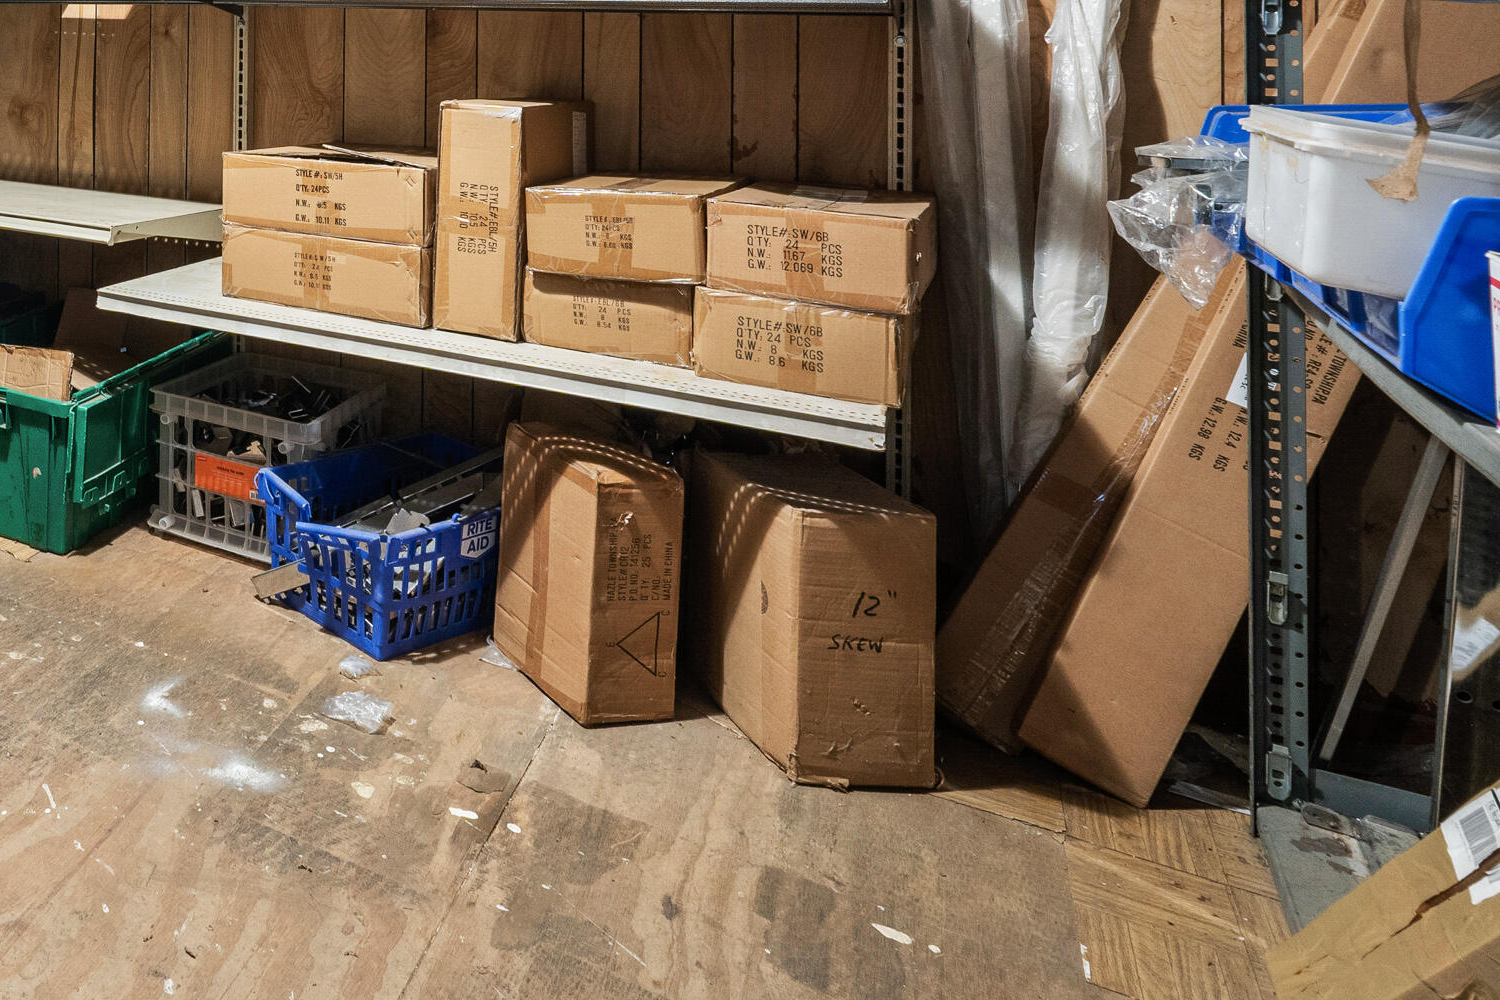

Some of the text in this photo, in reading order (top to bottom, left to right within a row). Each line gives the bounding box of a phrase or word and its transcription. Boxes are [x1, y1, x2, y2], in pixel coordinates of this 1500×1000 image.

[295, 168, 312, 178] STYLE
[334, 202, 346, 211] KGS
[334, 217, 347, 227] KGS
[477, 215, 488, 255] 24 PCS
[619, 233, 632, 241] KGS
[457, 236, 467, 253] KGS
[466, 237, 477, 255] KGS
[620, 242, 633, 250] KGS
[785, 239, 799, 250] 24
[821, 243, 842, 255] PCS
[821, 255, 843, 266] KGS
[780, 261, 814, 274] 12.069
[821, 266, 843, 278] KGS
[617, 308, 631, 316] PCS
[618, 316, 630, 324] KGS
[618, 324, 630, 332] KGS
[766, 332, 781, 344] 24
[789, 335, 811, 348] PCS
[770, 344, 777, 355] 8
[802, 349, 824, 361] KGS
[768, 355, 786, 367] 8.6
[801, 360, 824, 373] KGS
[1197, 416, 1218, 440] 12.98
[1188, 443, 1206, 461] KGS
[1213, 430, 1242, 473] 12.4 KGS
[467, 518, 493, 536] RITE
[466, 536, 490, 555] AID
[630, 537, 640, 568] 141256
[642, 533, 652, 569] 25 PCS
[663, 541, 674, 601] MADE IN CHINA
[607, 575, 616, 602] HAZLE
[827, 634, 884, 654] SKEW
